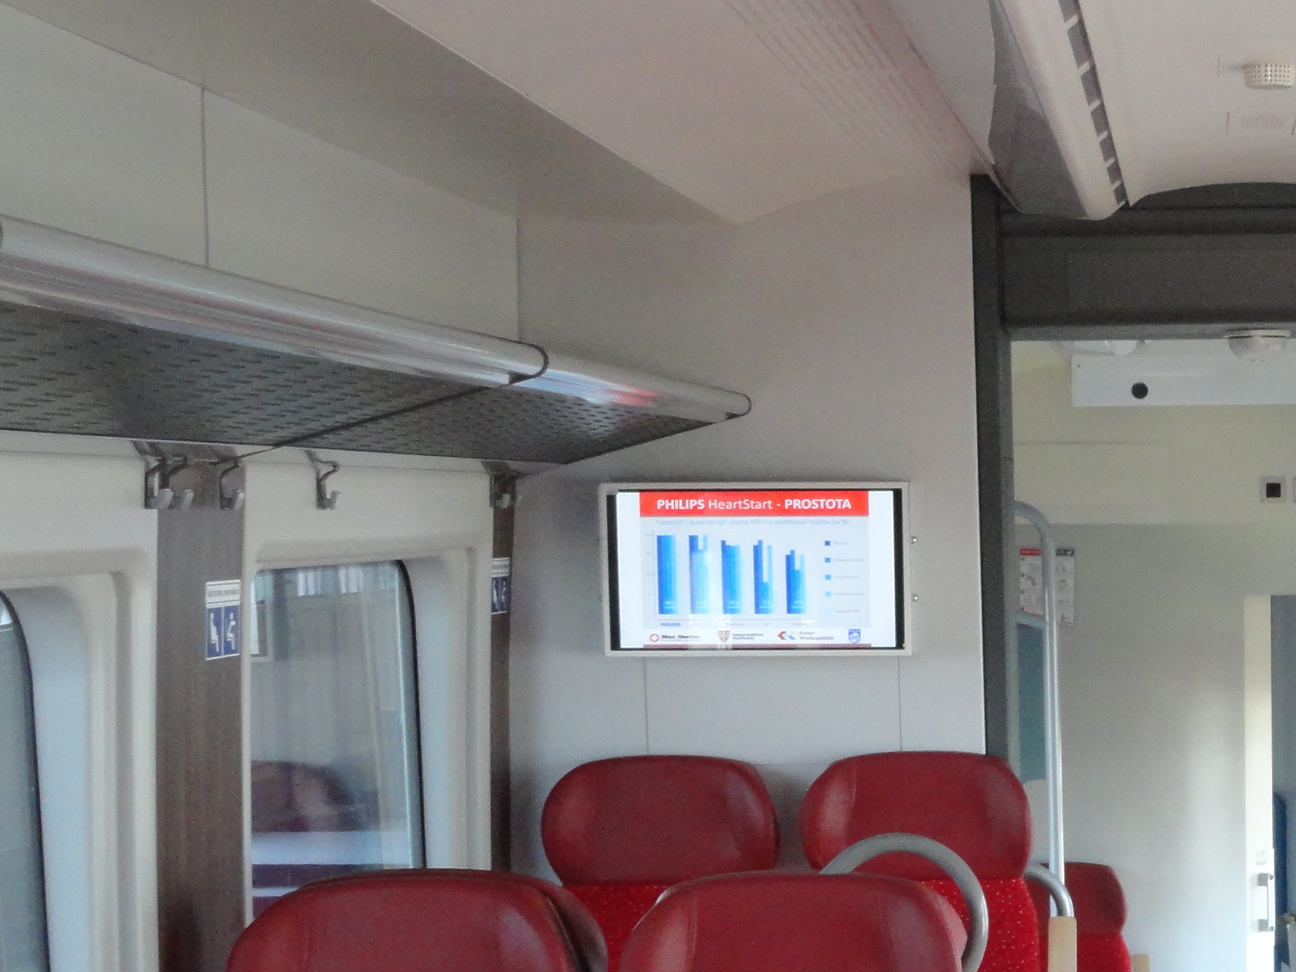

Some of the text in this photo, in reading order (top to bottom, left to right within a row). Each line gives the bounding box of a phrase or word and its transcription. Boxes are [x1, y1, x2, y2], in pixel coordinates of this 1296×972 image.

[657, 499, 705, 510] PHILIPS
[708, 499, 773, 510] HeartStart
[784, 498, 852, 510] PROSTOTA
